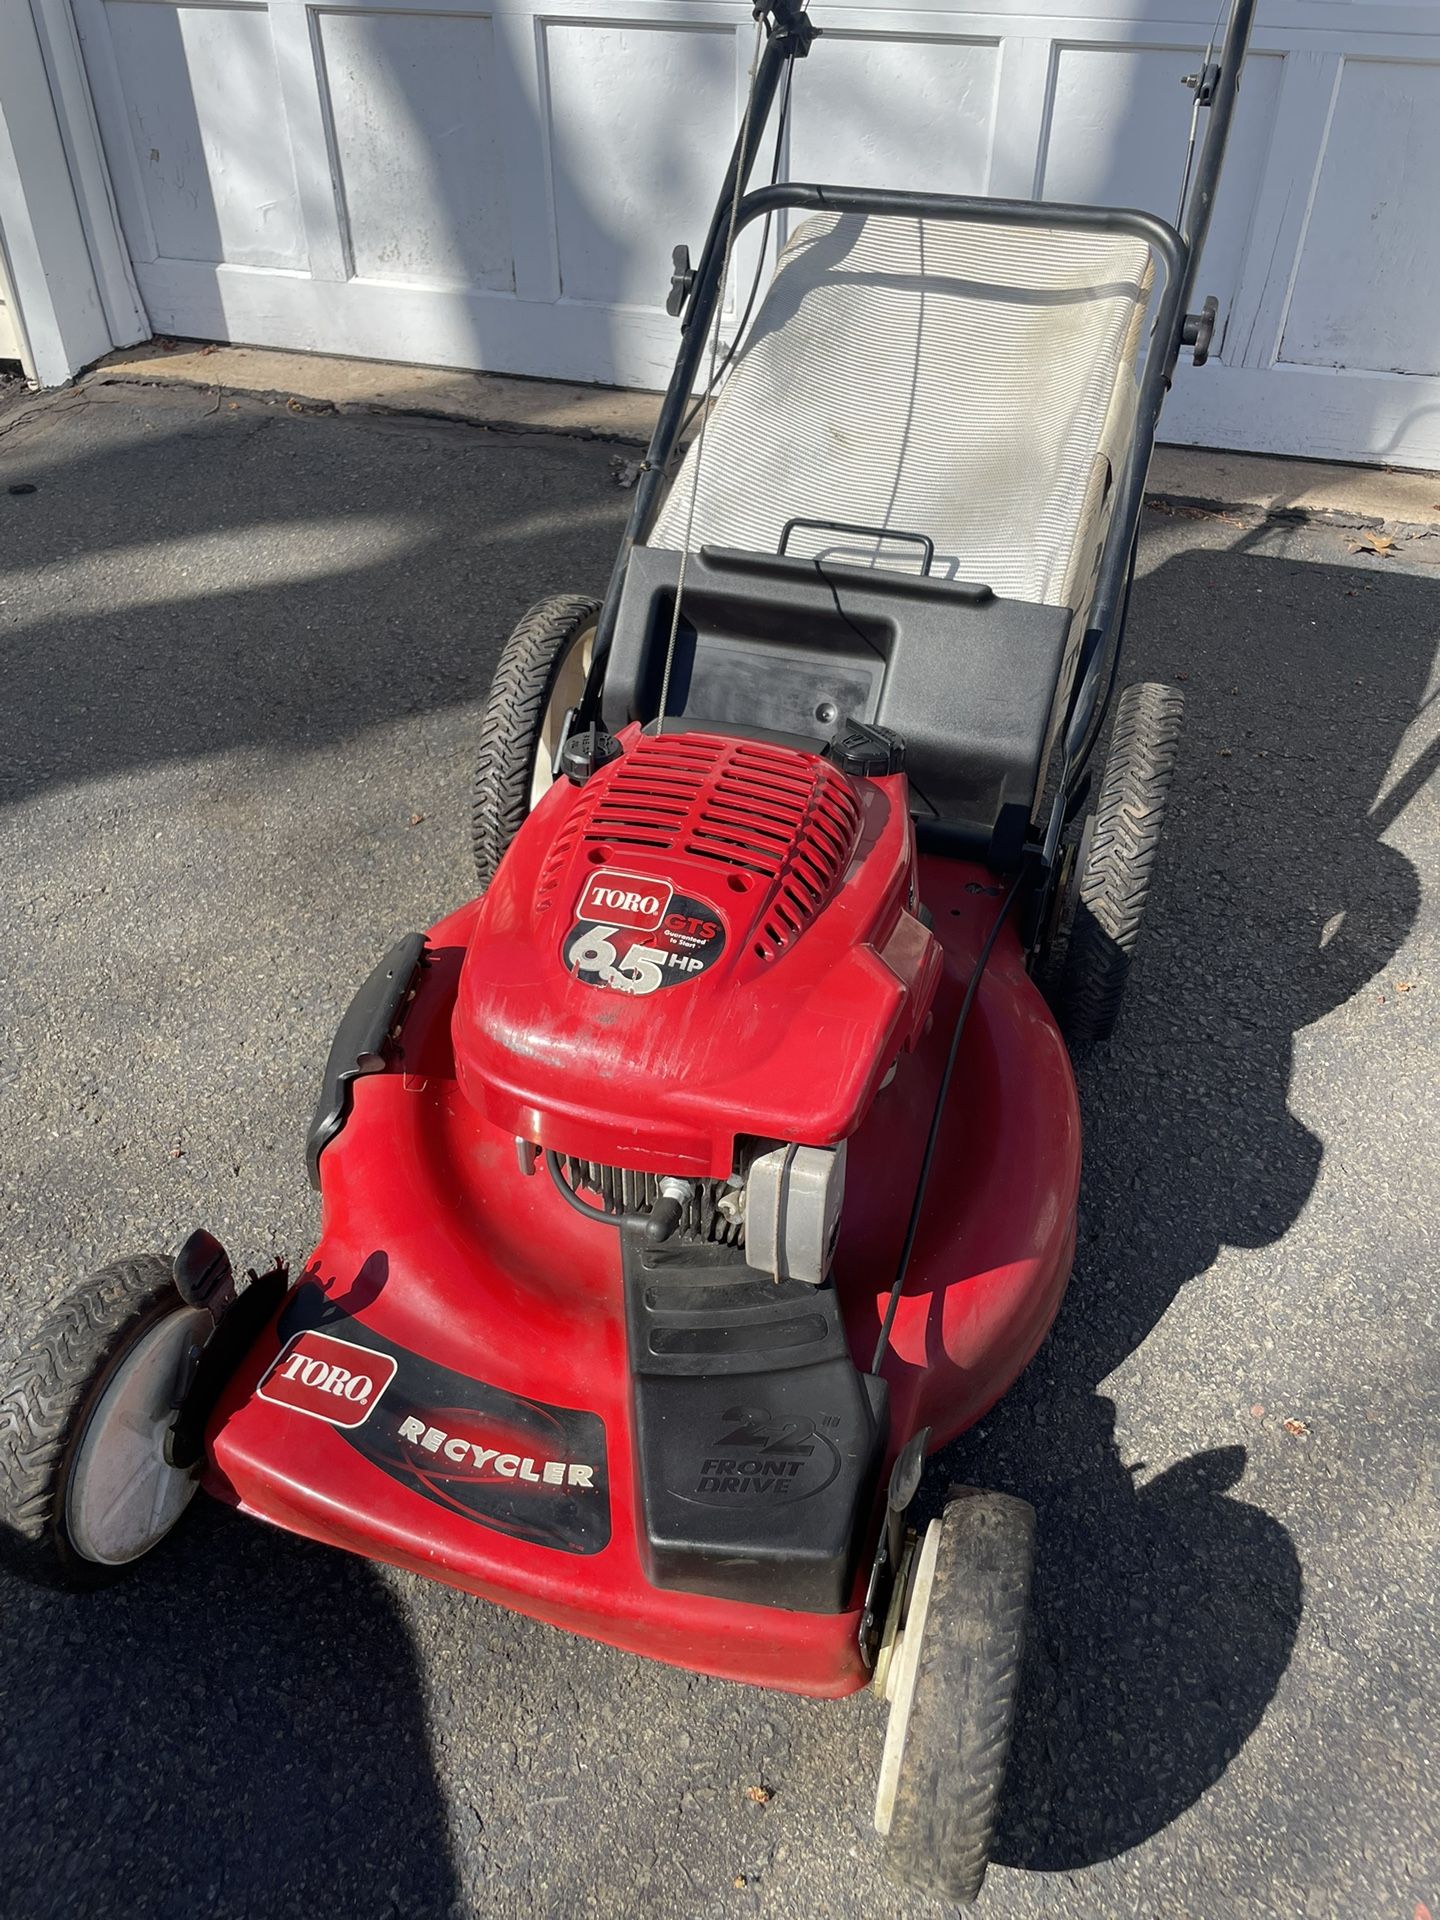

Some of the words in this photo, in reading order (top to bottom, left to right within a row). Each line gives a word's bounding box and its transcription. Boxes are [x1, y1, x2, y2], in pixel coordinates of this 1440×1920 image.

[591, 887, 660, 915] TORO
[664, 913, 718, 939] GTS
[664, 929, 707, 945] Guaranteed
[679, 939, 696, 949] Start
[668, 953, 704, 973] HP
[281, 1353, 373, 1402] TORO
[398, 1415, 594, 1488] RECYCLER
[700, 1459, 805, 1477] FRONT
[697, 1477, 792, 1494] DRIVE
